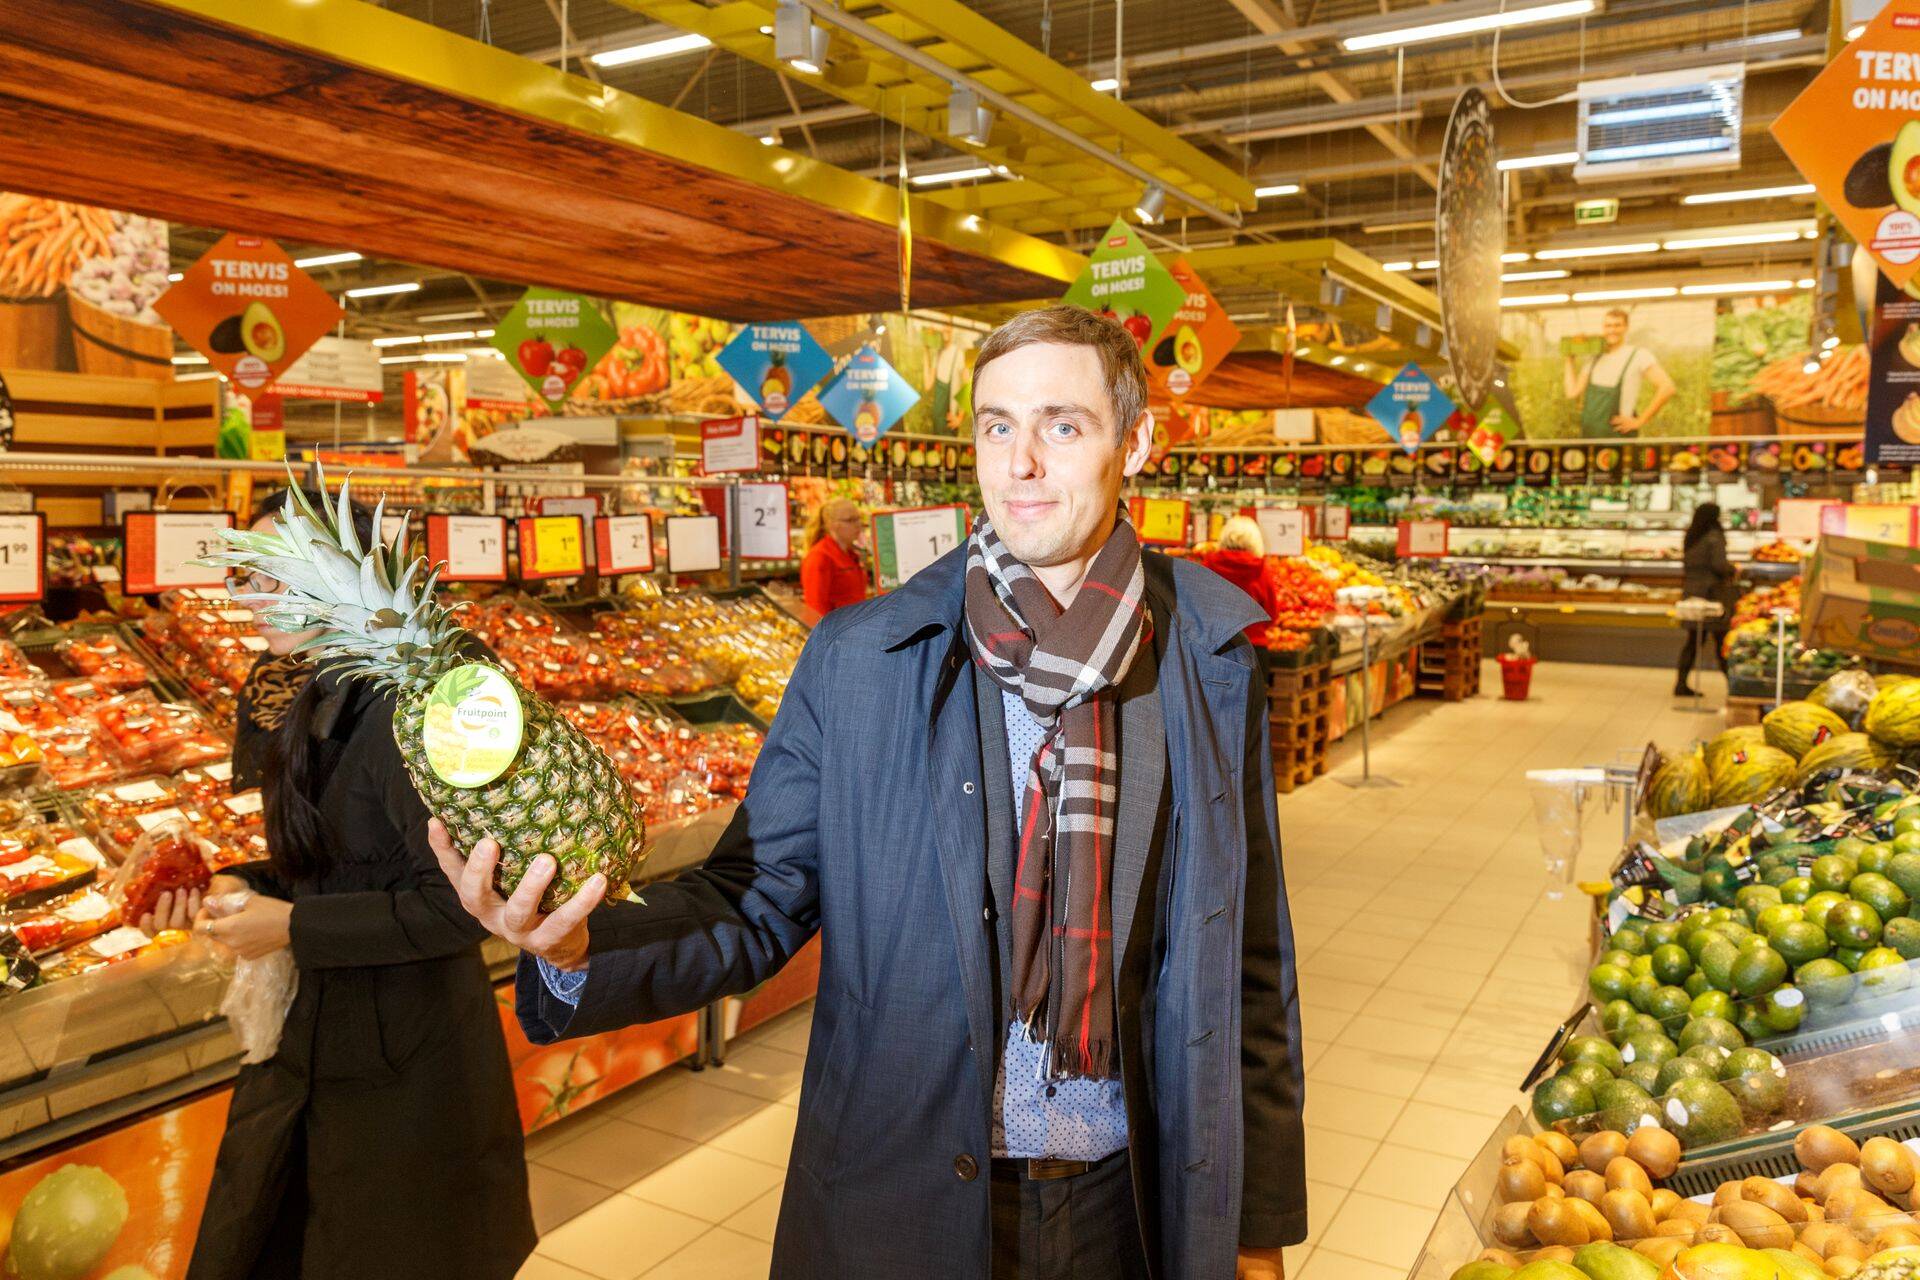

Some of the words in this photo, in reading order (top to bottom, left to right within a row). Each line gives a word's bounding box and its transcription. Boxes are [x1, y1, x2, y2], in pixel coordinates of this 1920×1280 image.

[1852, 86, 1887, 109] ON
[210, 259, 289, 281] TERVIS
[1091, 256, 1146, 280] TERVIS
[211, 281, 236, 296] ON
[238, 283, 289, 298] MOES!
[1091, 282, 1109, 298] ON
[1110, 278, 1145, 294] MOES!
[525, 299, 581, 315] TERVIS
[752, 326, 801, 341] TERVIS
[751, 341, 767, 352] ON
[754, 508, 767, 527] 2
[195, 540, 209, 559] 3
[928, 535, 939, 557] 1
[457, 707, 508, 719] Fruitpoint
